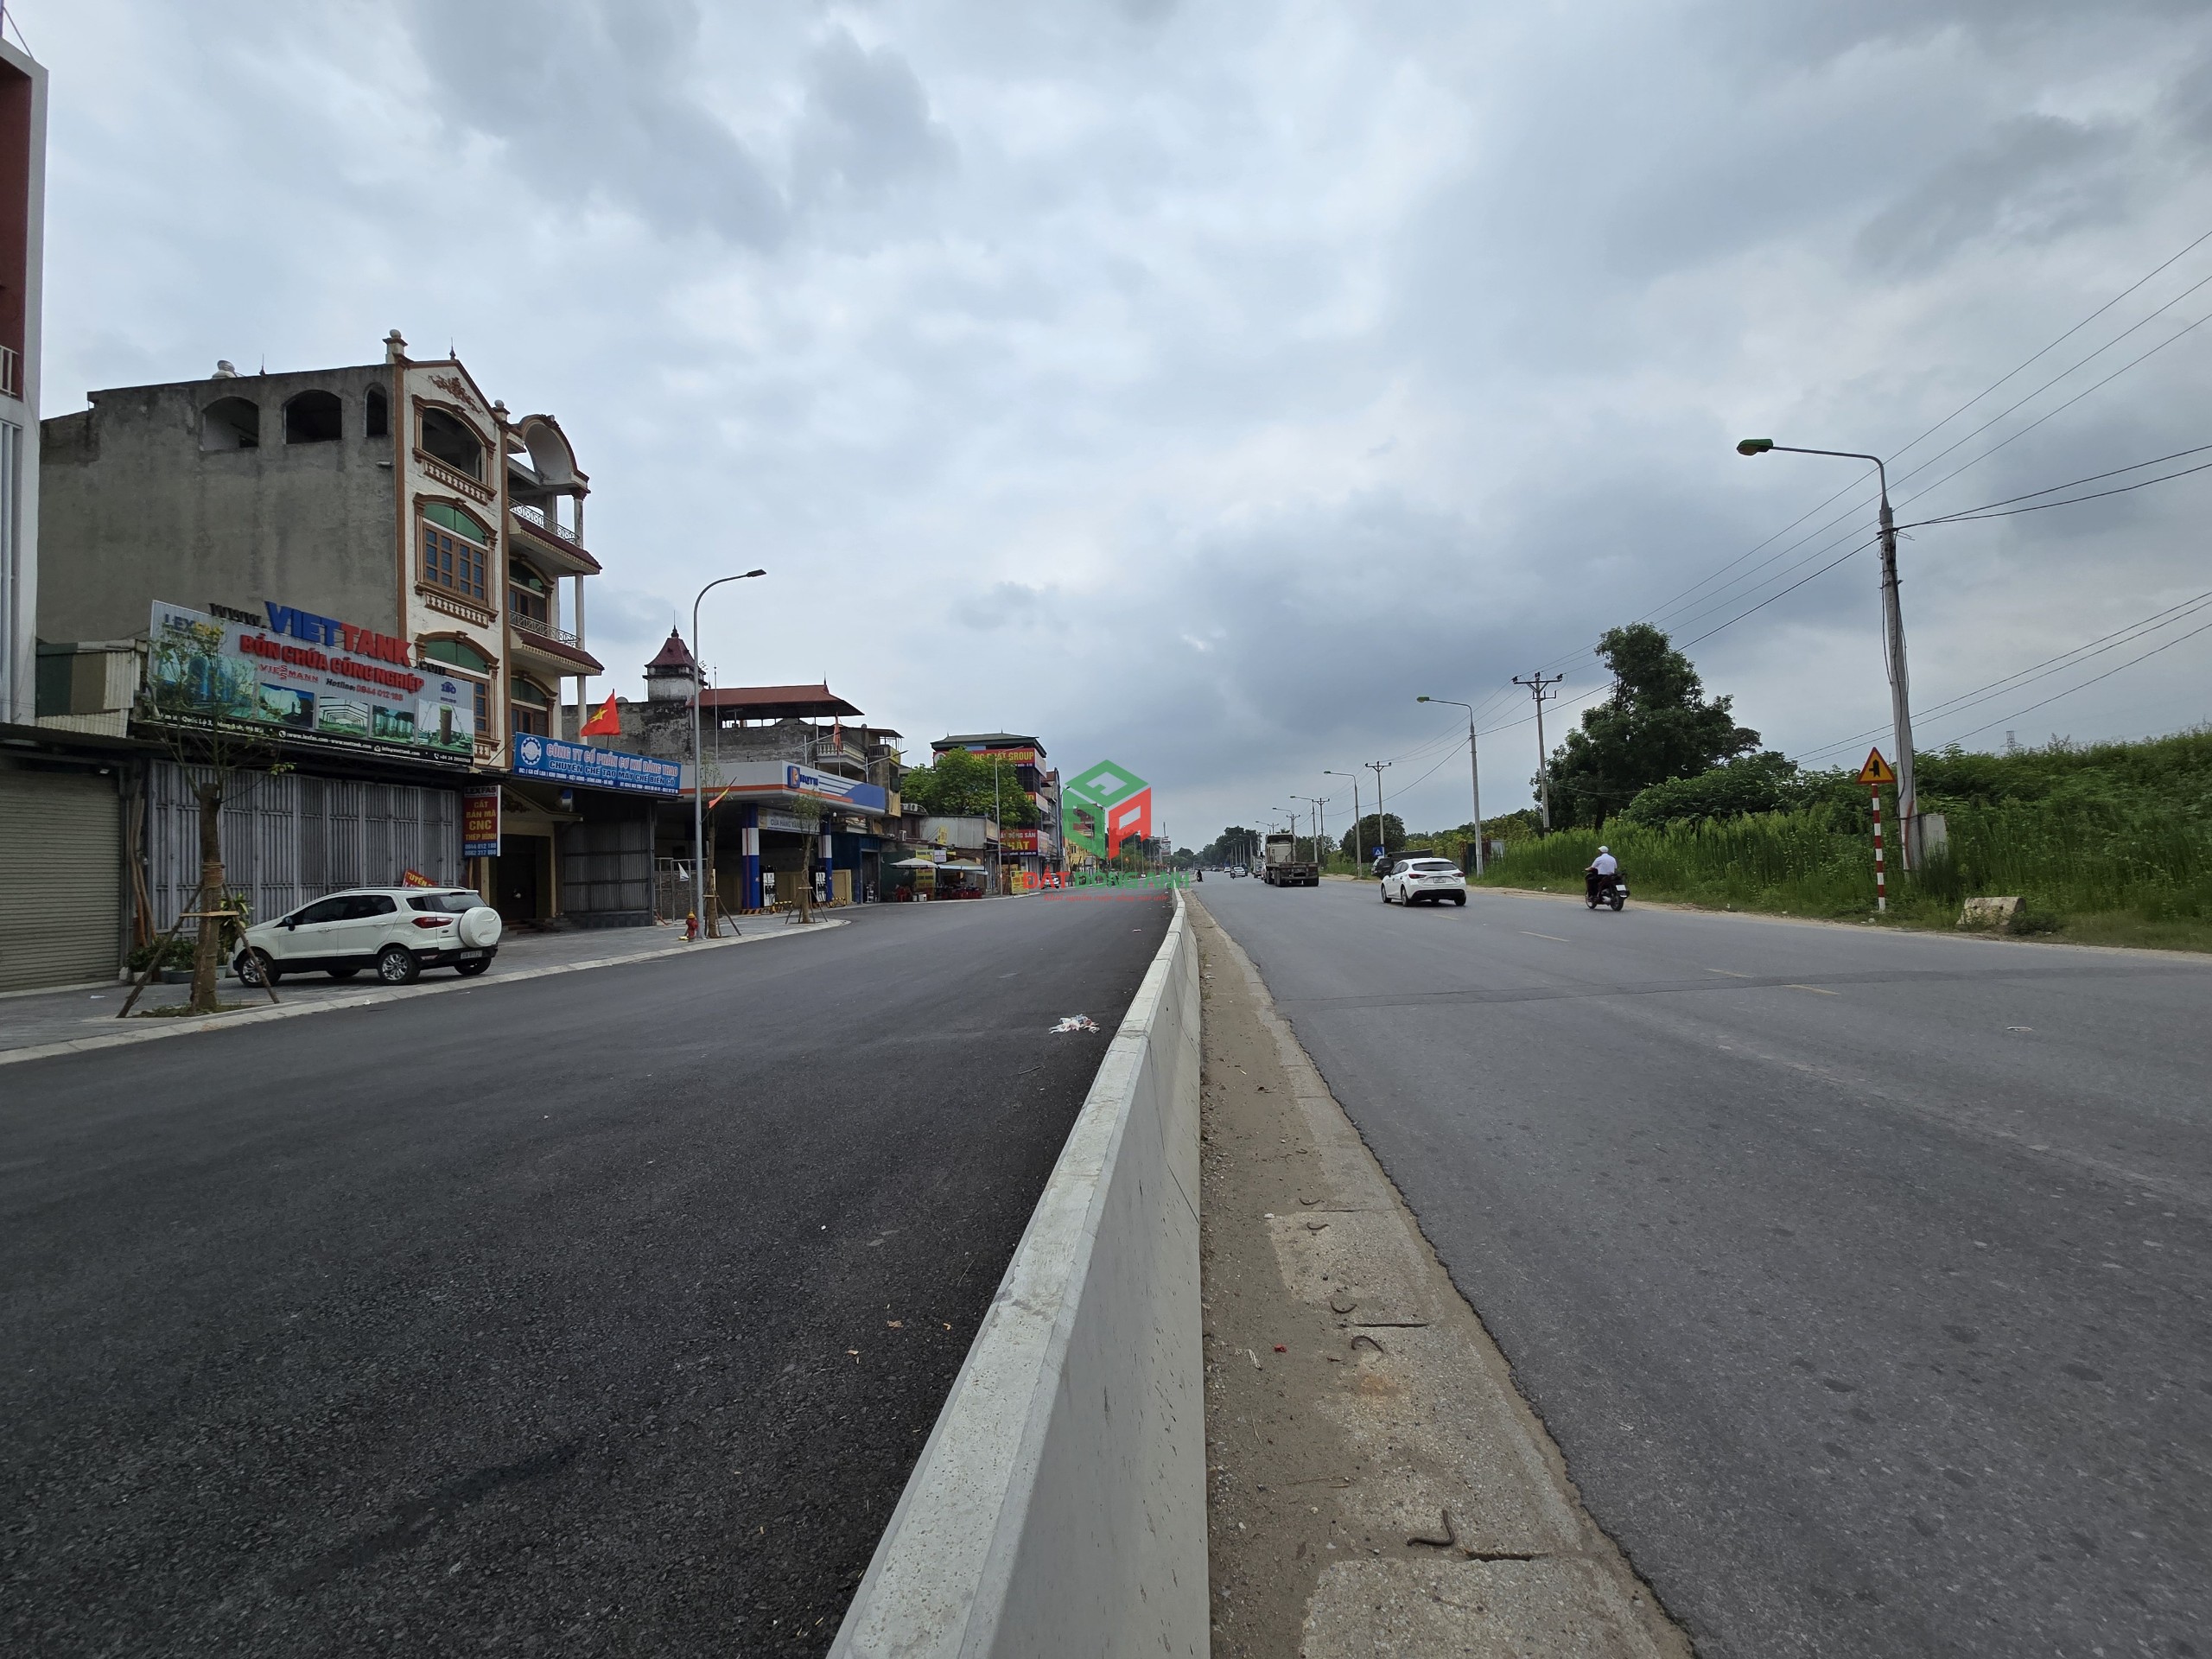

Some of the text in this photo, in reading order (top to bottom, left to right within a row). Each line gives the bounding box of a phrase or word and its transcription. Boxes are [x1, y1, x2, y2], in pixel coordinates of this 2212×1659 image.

[259, 664, 319, 682] VIESSMANN
[282, 647, 329, 671] CHỨA
[330, 657, 374, 681] CÔNG
[373, 667, 424, 694] NGHIỆP
[326, 678, 356, 690] Hotline:
[546, 742, 571, 760] CÔNG
[572, 747, 583, 761] TY
[584, 747, 596, 764] CỔ
[596, 751, 619, 767] PHẦN
[1008, 751, 1033, 761] GROUP
[585, 765, 601, 775] CHẾ
[469, 820, 492, 830] CNC
